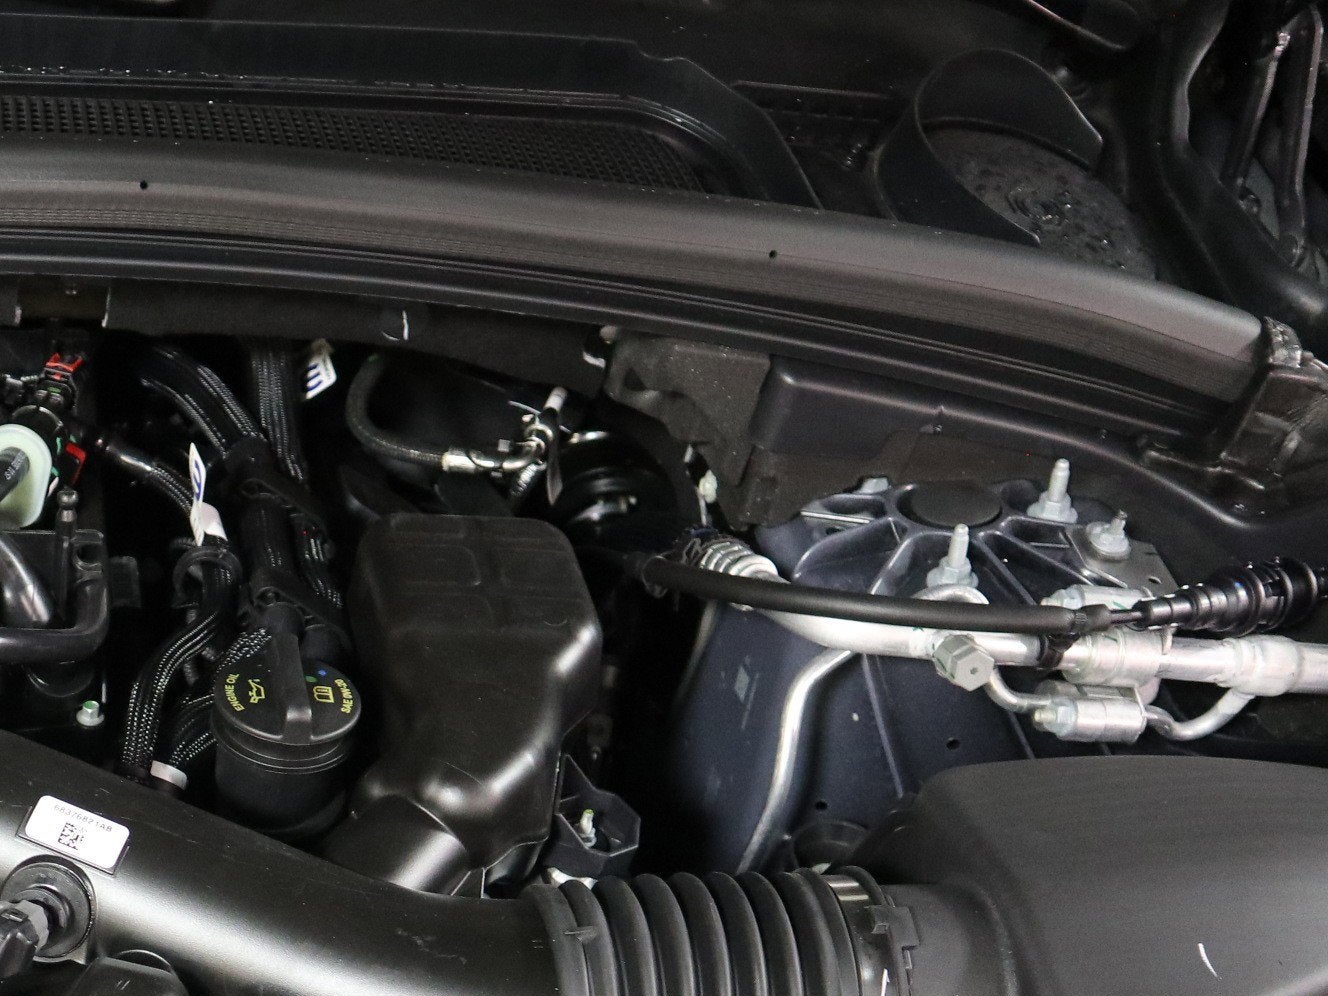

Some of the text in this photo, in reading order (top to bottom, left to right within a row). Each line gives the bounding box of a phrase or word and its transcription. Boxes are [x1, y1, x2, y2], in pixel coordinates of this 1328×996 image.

[224, 673, 246, 712] ENGINE OIL
[340, 699, 354, 714] SAE
